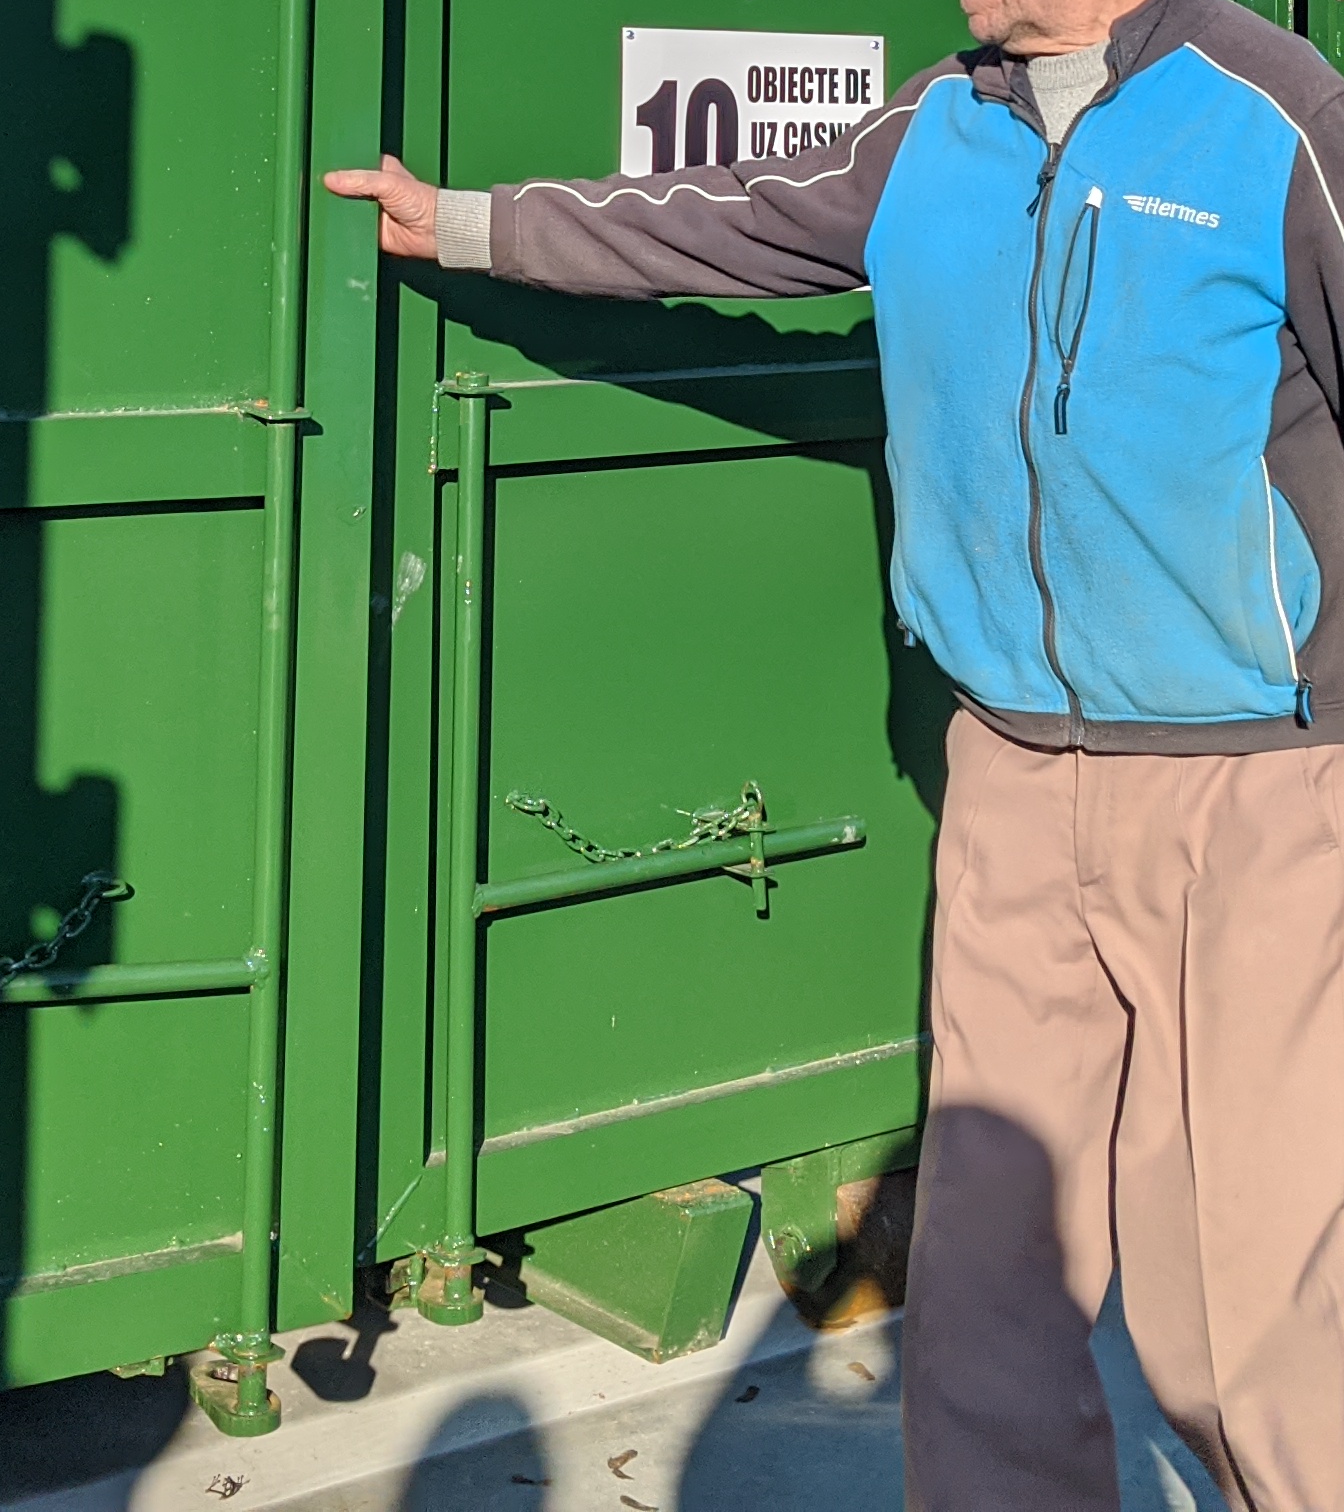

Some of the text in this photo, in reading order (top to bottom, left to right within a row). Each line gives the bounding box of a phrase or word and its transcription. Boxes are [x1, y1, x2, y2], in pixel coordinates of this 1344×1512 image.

[747, 65, 871, 104] OBIECTE DE
[636, 77, 739, 173] 10
[751, 121, 851, 159] UZ CASN
[1144, 195, 1220, 229] Hermes
